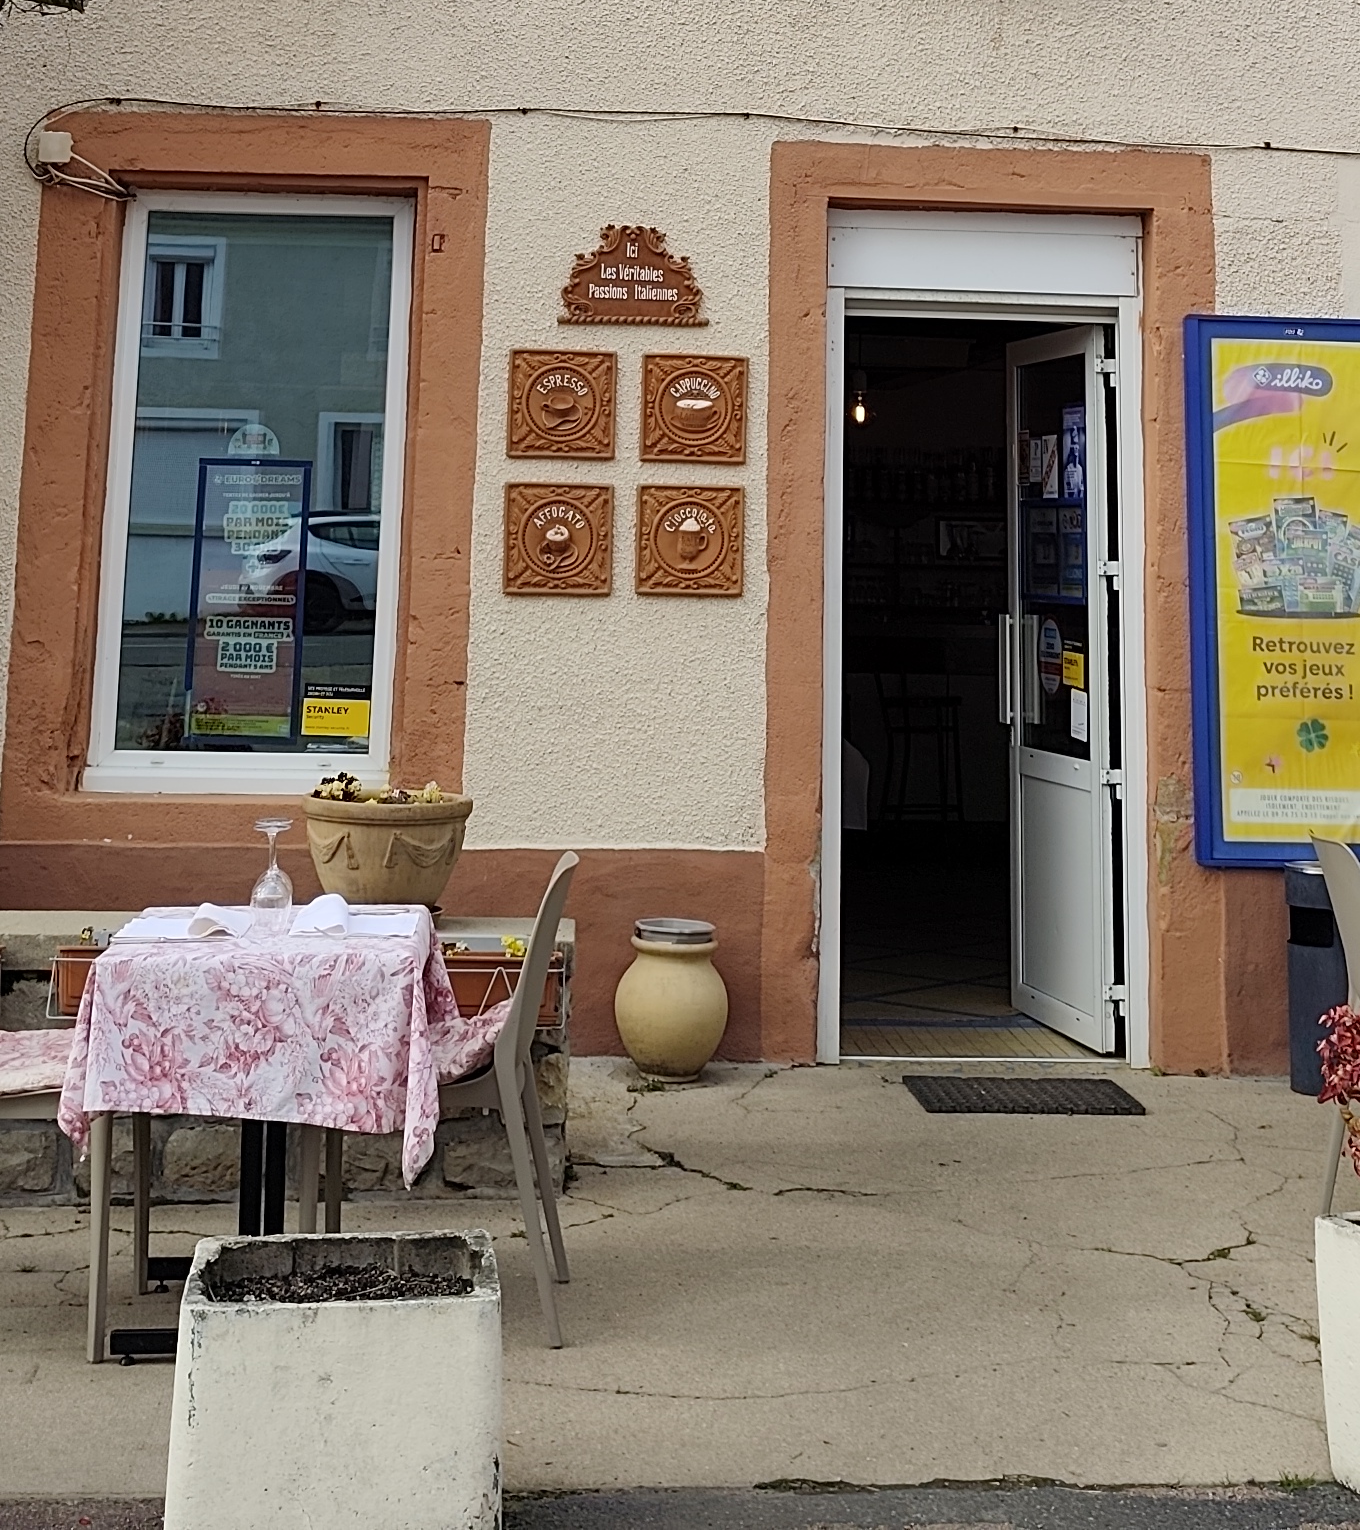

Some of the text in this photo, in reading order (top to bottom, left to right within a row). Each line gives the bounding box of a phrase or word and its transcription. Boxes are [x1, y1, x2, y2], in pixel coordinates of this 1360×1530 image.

[626, 242, 639, 258] Ici
[601, 263, 664, 282] Les Véritables
[588, 283, 678, 301] Passions Italiennes
[536, 374, 588, 396] ESPRESSO
[1271, 367, 1323, 390] illiko
[670, 377, 721, 400] CAPPUCCINO
[231, 504, 248, 514] 20
[533, 506, 585, 530] AFFOGATO
[226, 517, 252, 527] PAR
[227, 529, 287, 540] PENDANT
[208, 618, 291, 631] 10 GAGNANTS
[221, 641, 274, 653] 2 000 €
[1252, 636, 1355, 655] Retrouvez
[220, 653, 274, 663] PAR MOIS
[1263, 659, 1345, 679] vos jeux
[1256, 681, 1354, 701] préférés !
[306, 705, 349, 715] STANLEY
